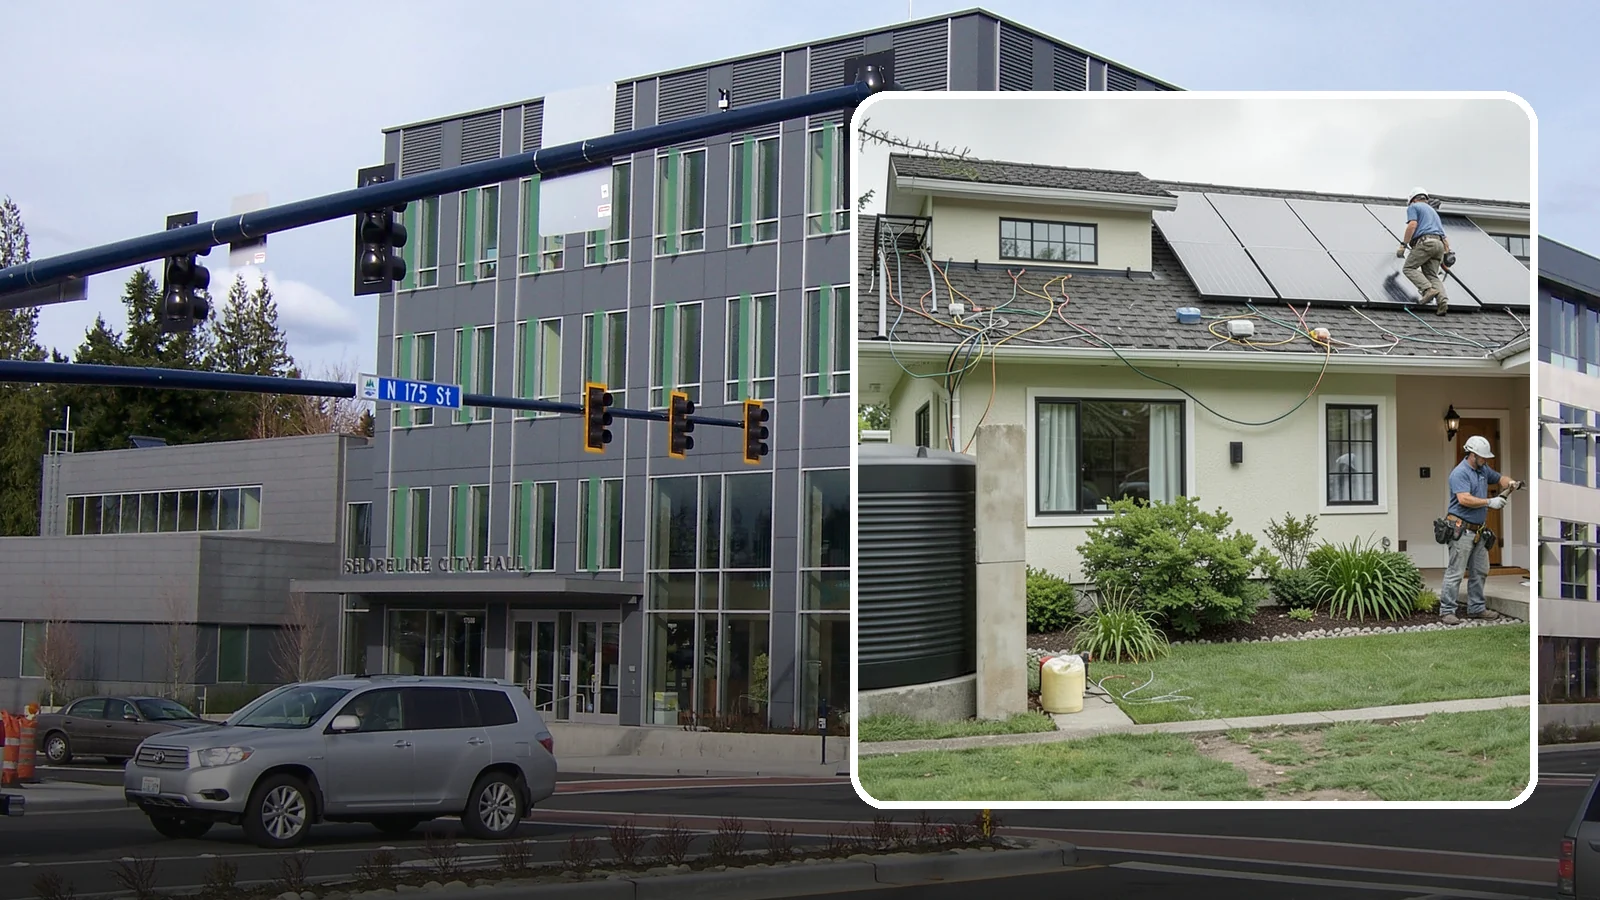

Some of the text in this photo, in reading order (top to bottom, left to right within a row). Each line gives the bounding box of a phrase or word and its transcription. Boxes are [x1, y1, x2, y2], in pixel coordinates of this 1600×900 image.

[387, 380, 451, 406] N 175 St
[344, 554, 526, 574] SHORELINE CITY HALL
